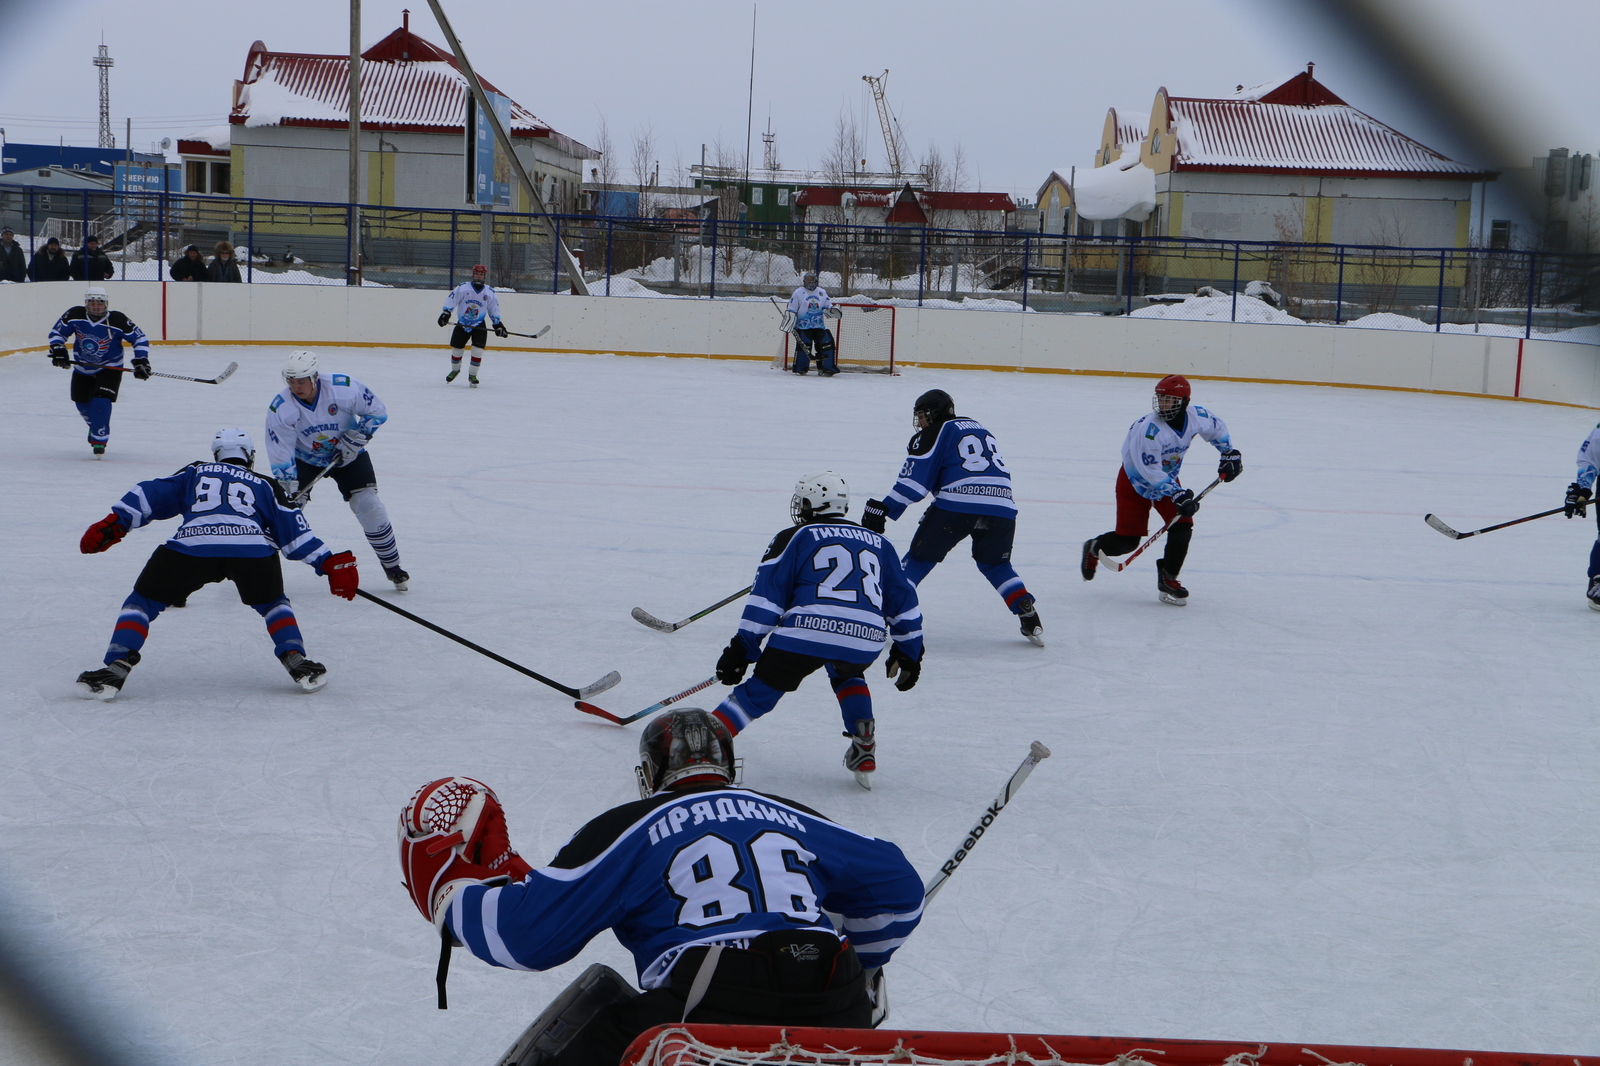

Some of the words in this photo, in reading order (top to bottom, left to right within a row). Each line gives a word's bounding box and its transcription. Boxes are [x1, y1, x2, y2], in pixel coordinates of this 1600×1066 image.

[1141, 452, 1158, 467] 62
[808, 526, 882, 549] ТИХОНОВ
[811, 543, 883, 614] 28
[648, 797, 806, 847] ПРЯДКИН
[940, 799, 1004, 877] Reebok
[666, 830, 822, 929] 86
